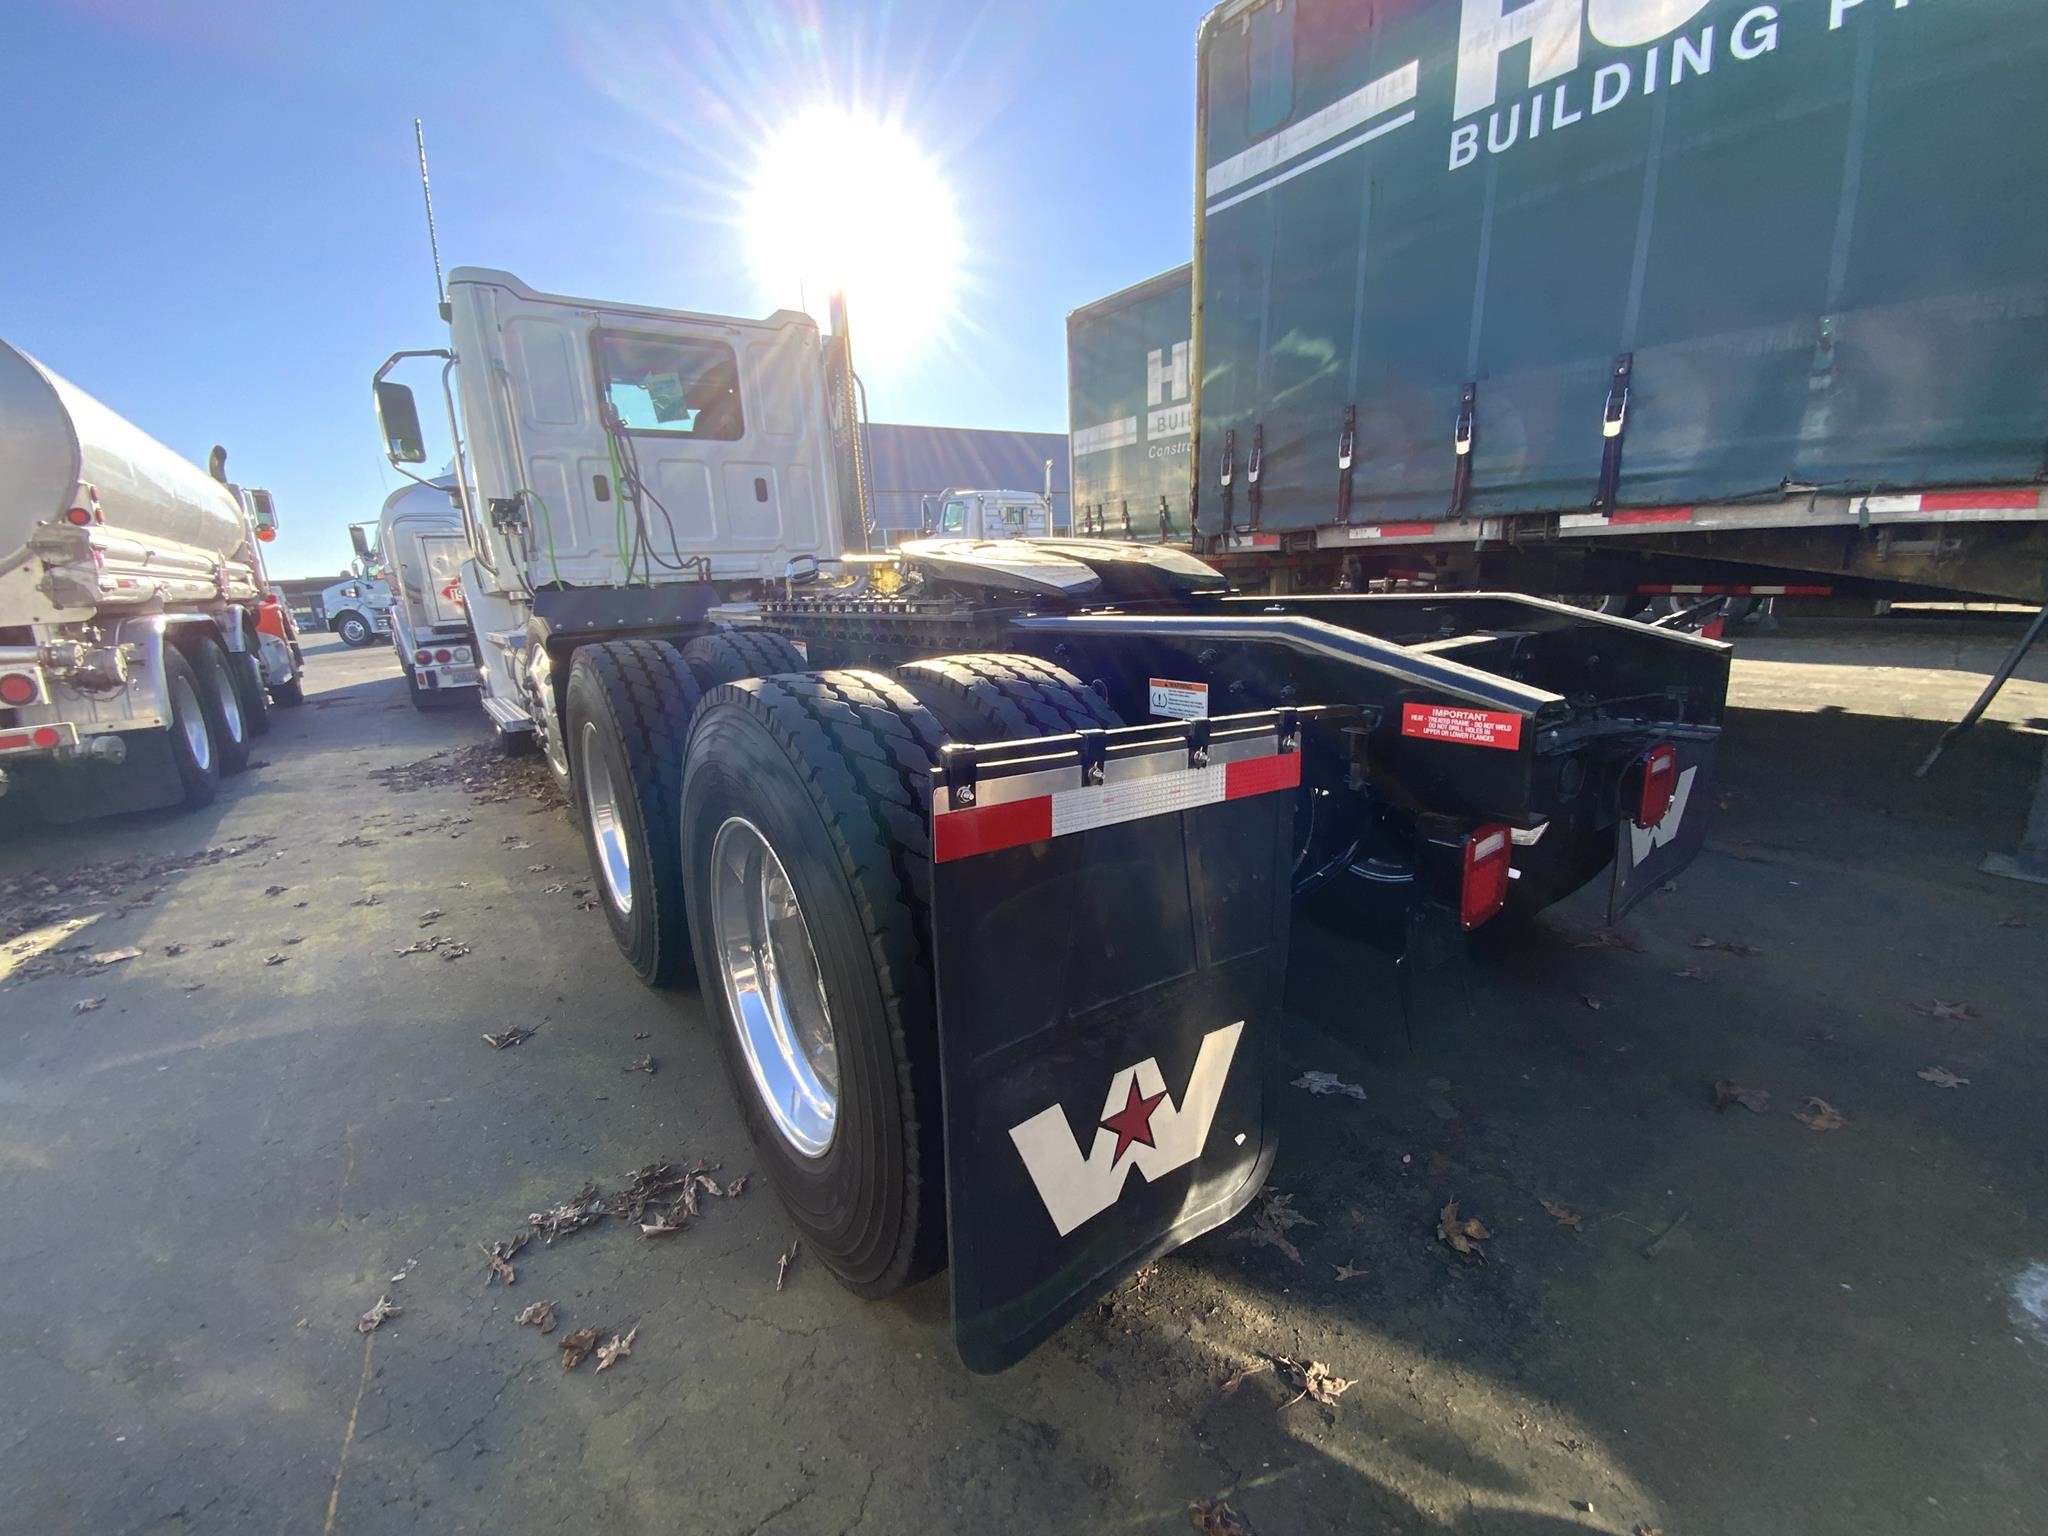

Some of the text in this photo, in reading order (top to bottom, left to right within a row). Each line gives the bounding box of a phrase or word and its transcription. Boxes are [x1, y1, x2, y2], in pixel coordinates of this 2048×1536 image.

[1448, 4, 1780, 171] BUILDING
[1432, 708, 1488, 721] IMPORTANT
[1428, 716, 1450, 725] TREATED
[1451, 719, 1470, 727] FRAME
[1495, 724, 1512, 732] WELD
[1448, 724, 1464, 732] DRILL
[1465, 726, 1483, 734] HOLES
[1423, 728, 1440, 736] UPPER
[1449, 731, 1469, 739] LOWER
[1469, 733, 1495, 742] FLANGES
